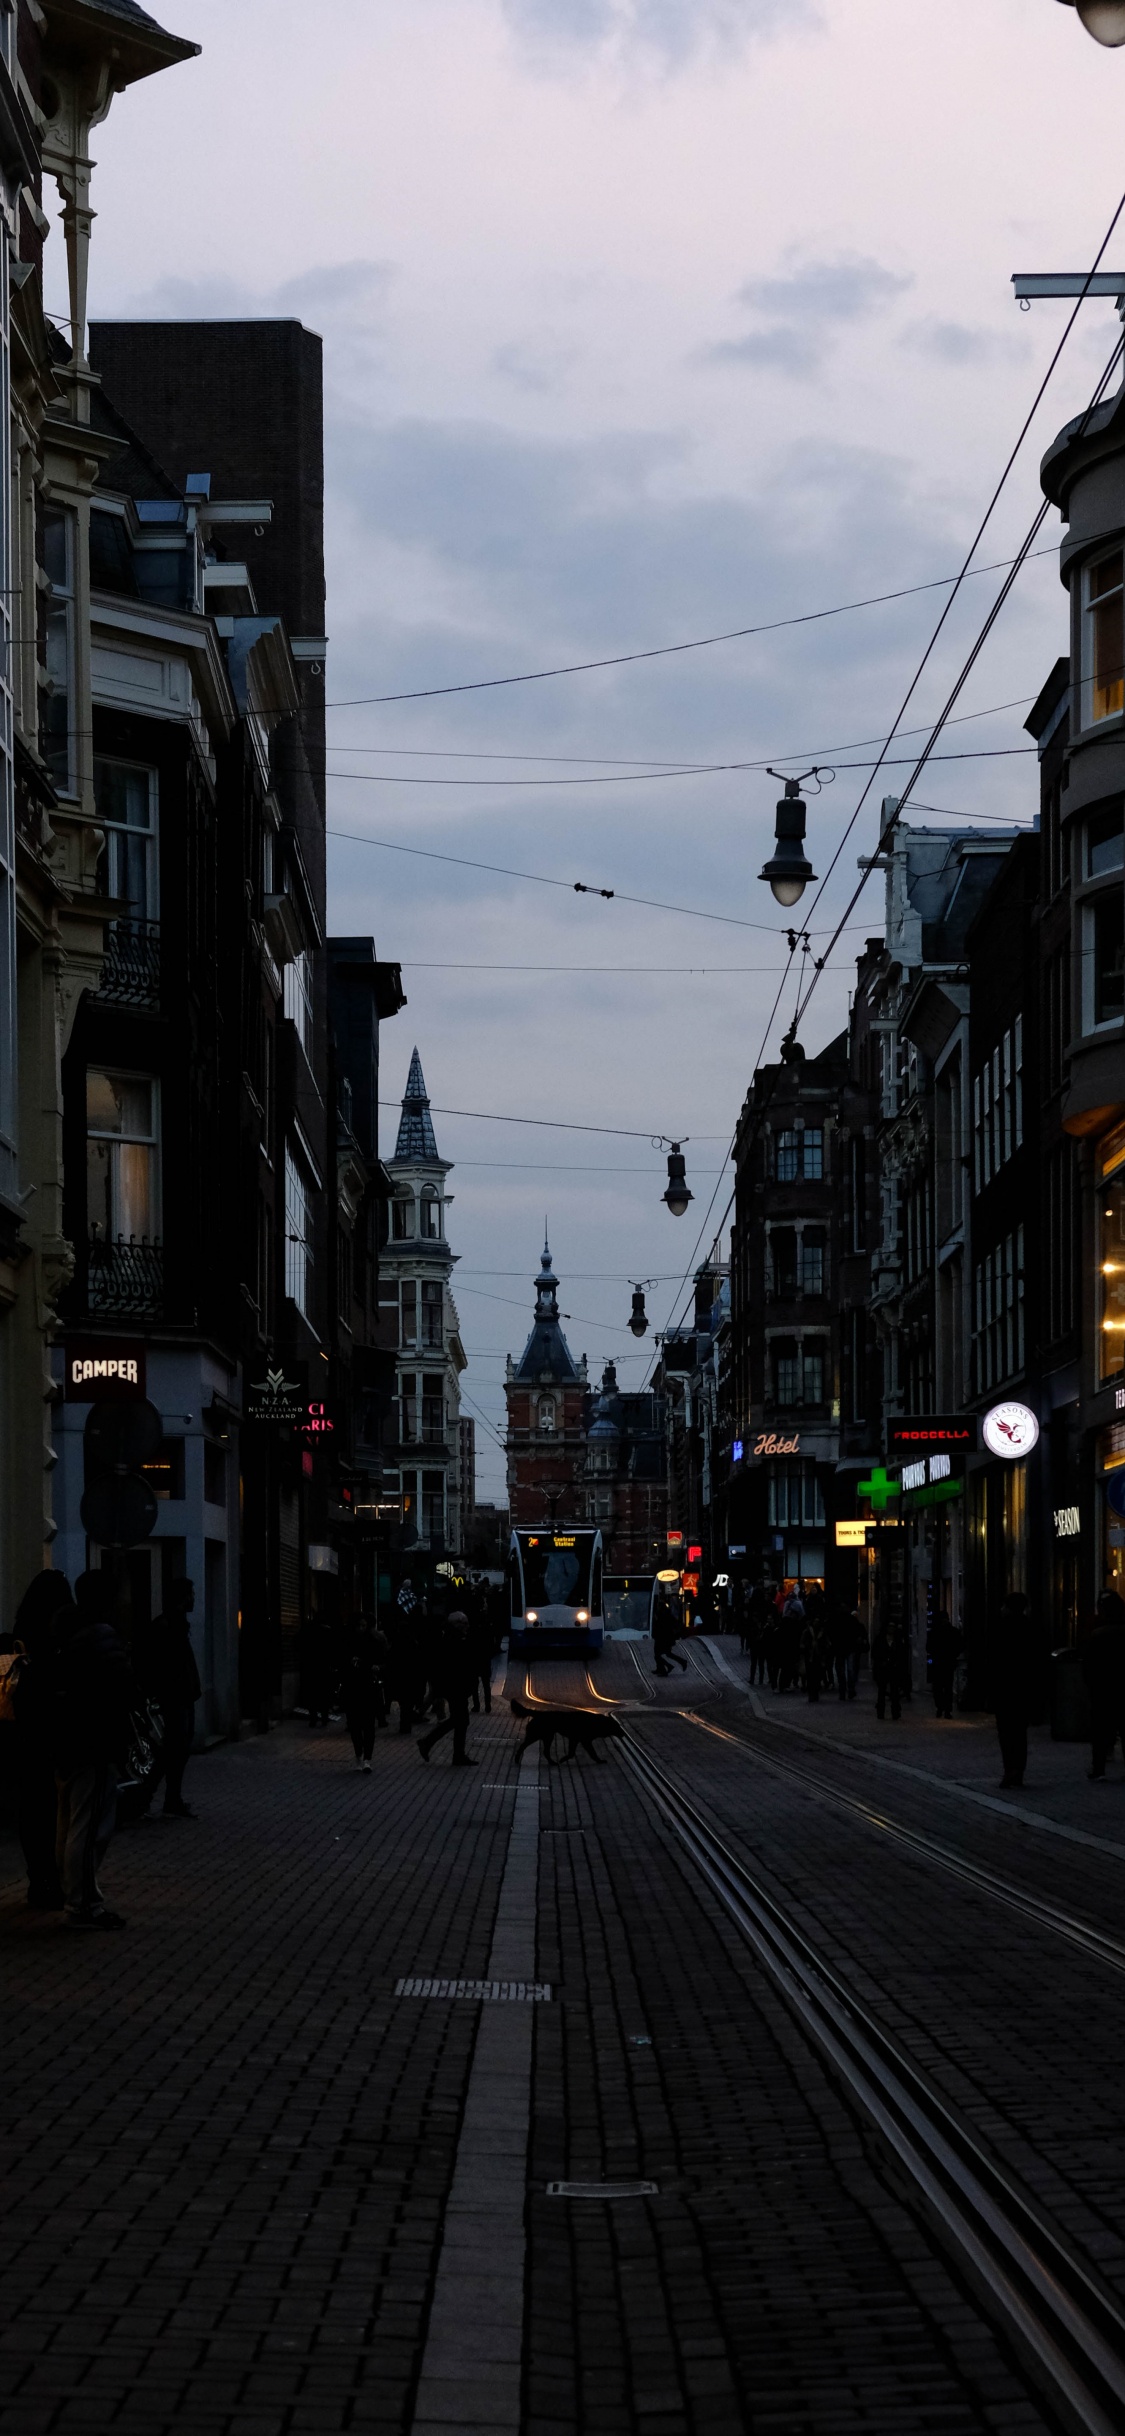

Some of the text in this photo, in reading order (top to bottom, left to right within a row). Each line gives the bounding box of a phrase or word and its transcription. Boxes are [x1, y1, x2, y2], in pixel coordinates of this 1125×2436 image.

[72, 1360, 138, 1384] CAMPER
[992, 1407, 1028, 1420] SEASONS
[754, 1434, 800, 1455] Hotel
[712, 1574, 729, 1587] JD
